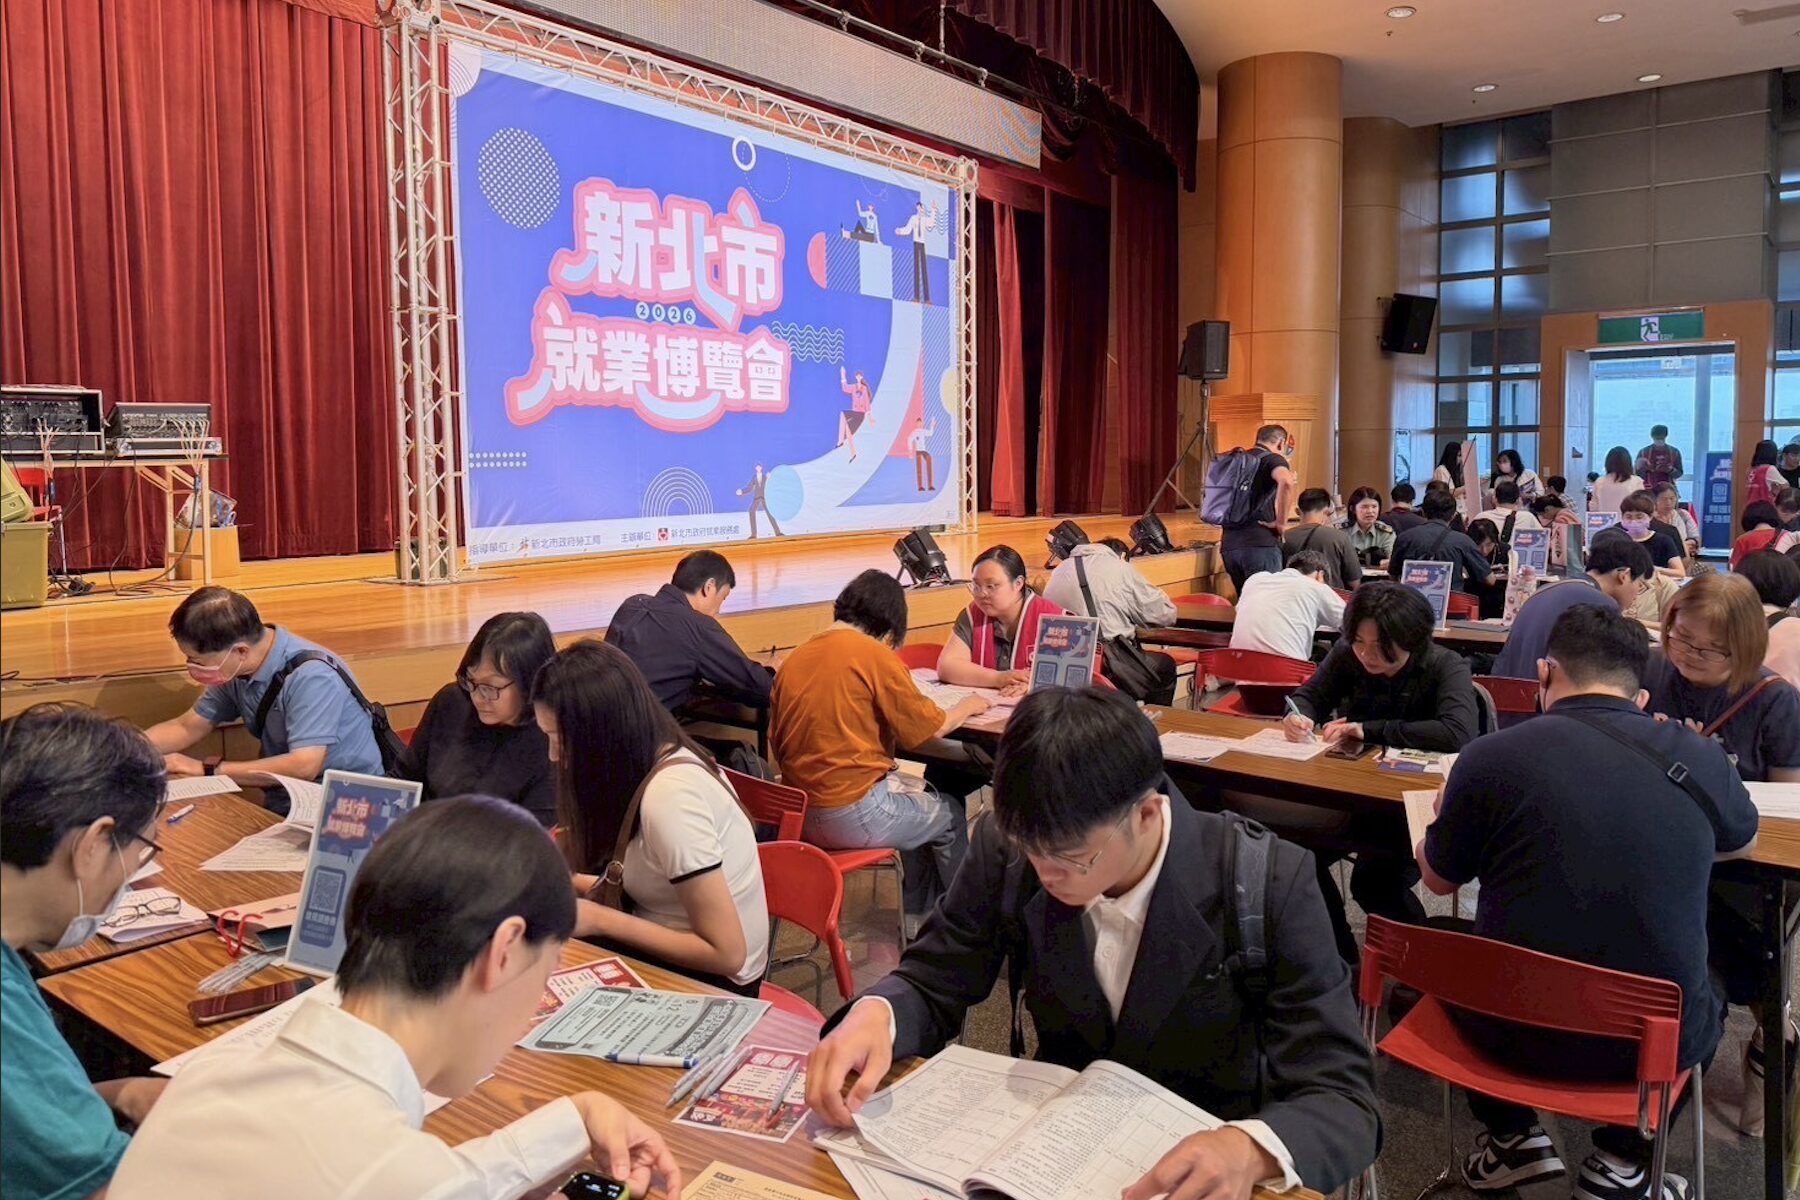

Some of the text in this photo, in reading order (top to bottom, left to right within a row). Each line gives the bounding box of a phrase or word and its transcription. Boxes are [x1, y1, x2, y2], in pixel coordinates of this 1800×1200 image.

[560, 191, 778, 325] 新北市
[637, 303, 695, 324] 2026
[518, 301, 784, 412] 就業博覽會
